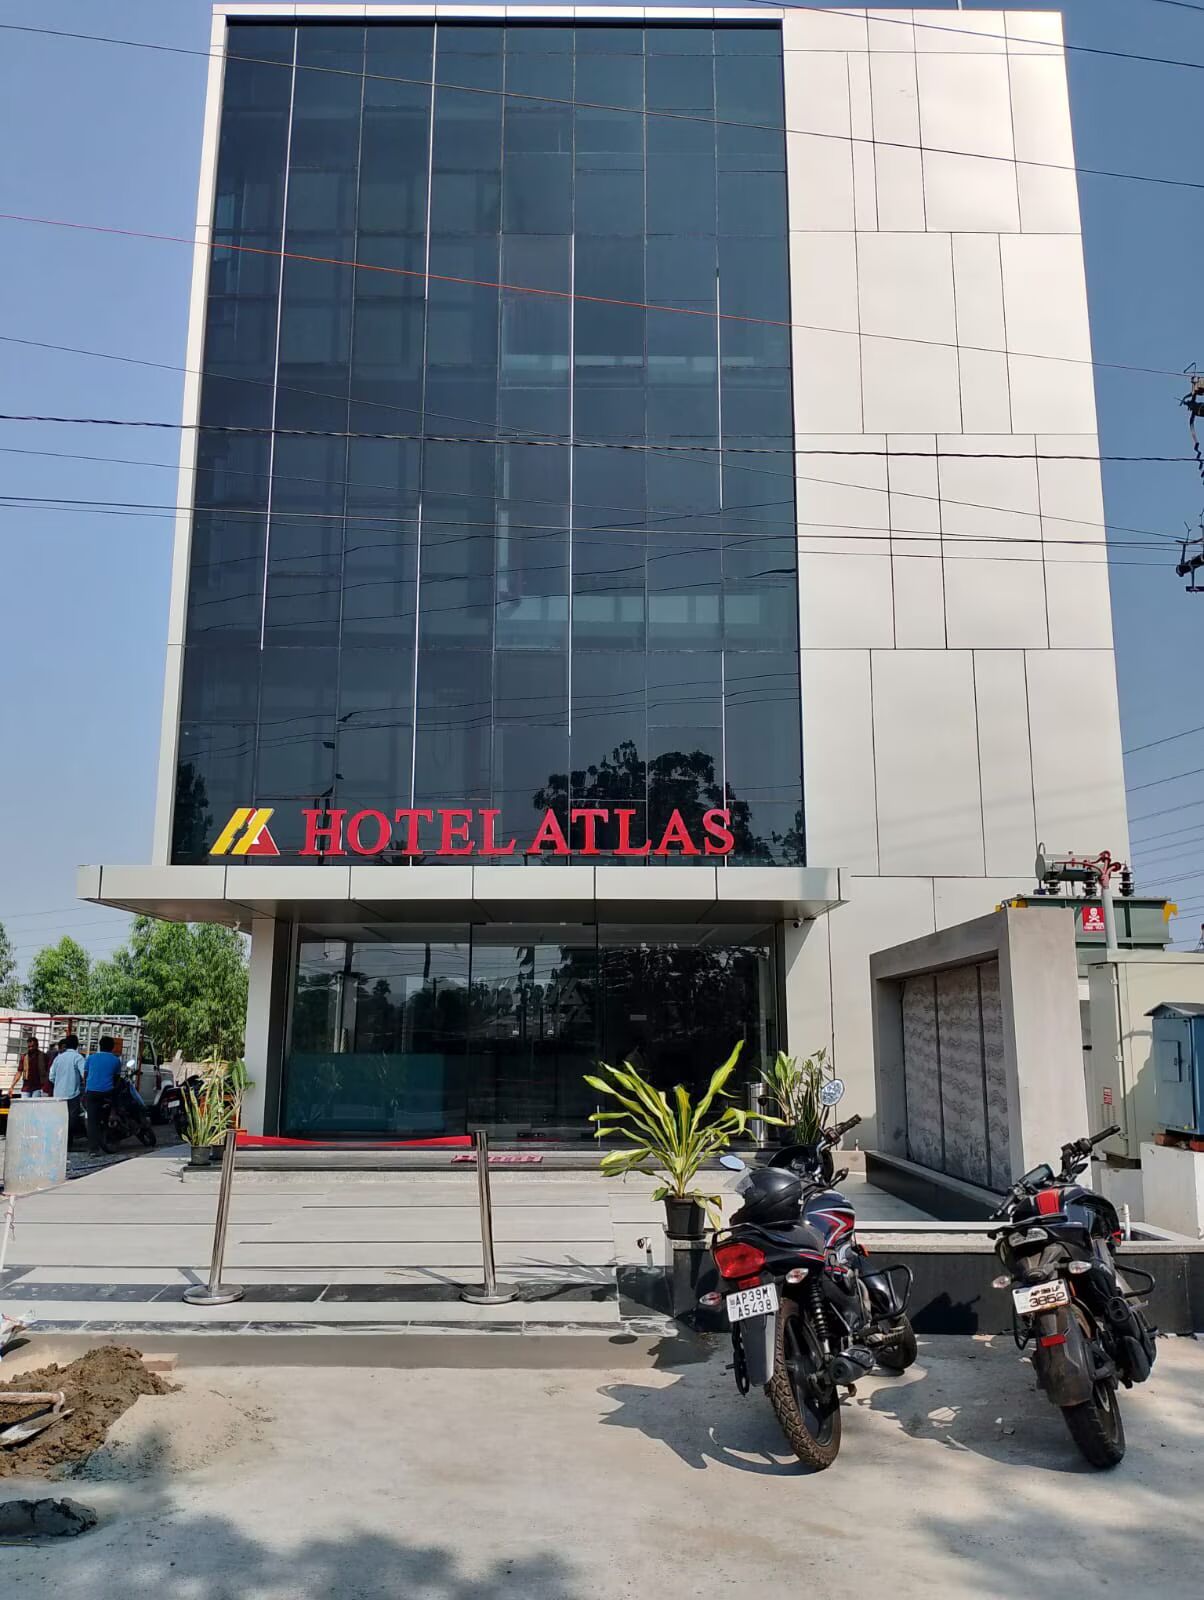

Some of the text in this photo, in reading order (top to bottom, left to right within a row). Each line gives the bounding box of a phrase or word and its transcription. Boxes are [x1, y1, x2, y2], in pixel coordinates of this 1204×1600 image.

[299, 808, 735, 855] HOTEL ATLAS
[736, 1287, 769, 1306] AP39M
[1029, 1291, 1066, 1308] 3852
[739, 1299, 772, 1318] A5438
